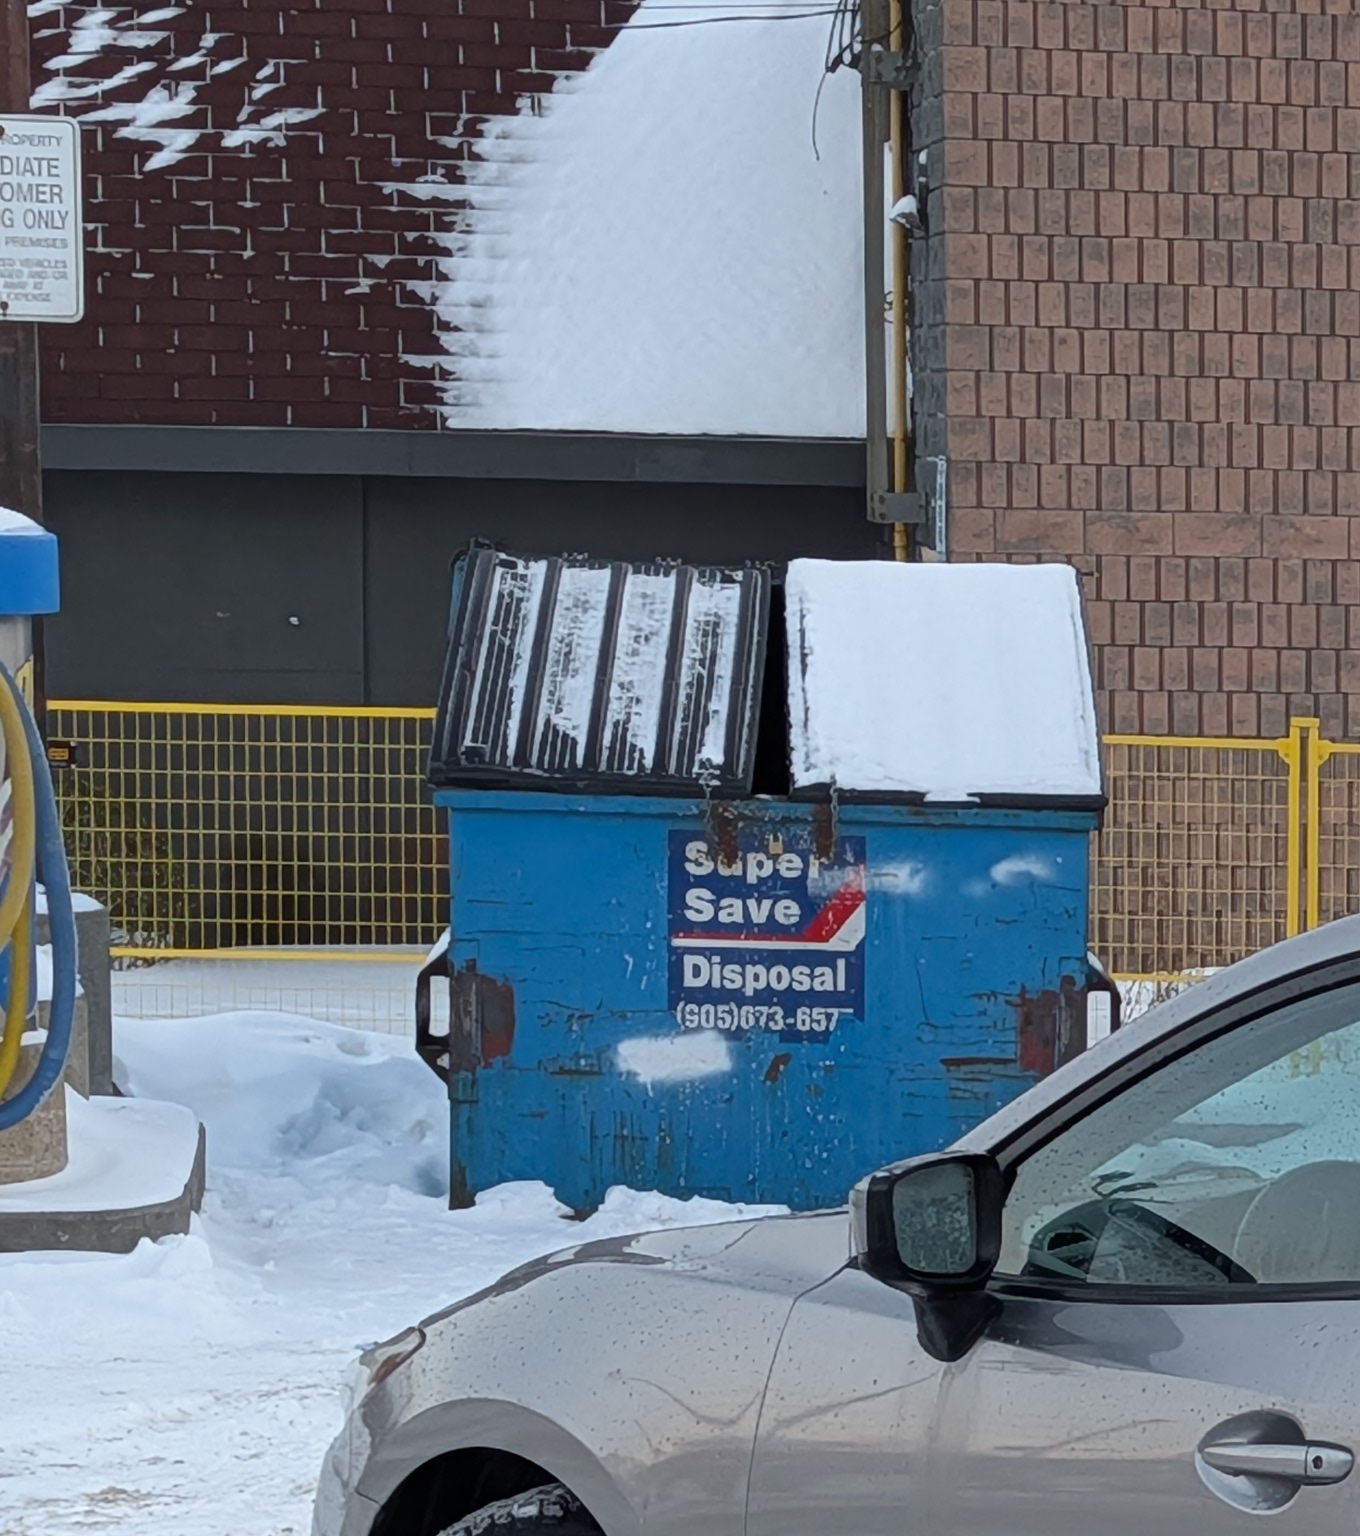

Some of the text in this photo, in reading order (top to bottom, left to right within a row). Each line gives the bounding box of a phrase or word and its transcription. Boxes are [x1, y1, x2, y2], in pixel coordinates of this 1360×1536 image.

[0, 182, 63, 204] OMER
[23, 208, 68, 230] ONLY
[684, 841, 829, 884] Super
[684, 888, 801, 925] Save
[683, 954, 846, 996] Disposal
[676, 1000, 854, 1032] (905)673-657
